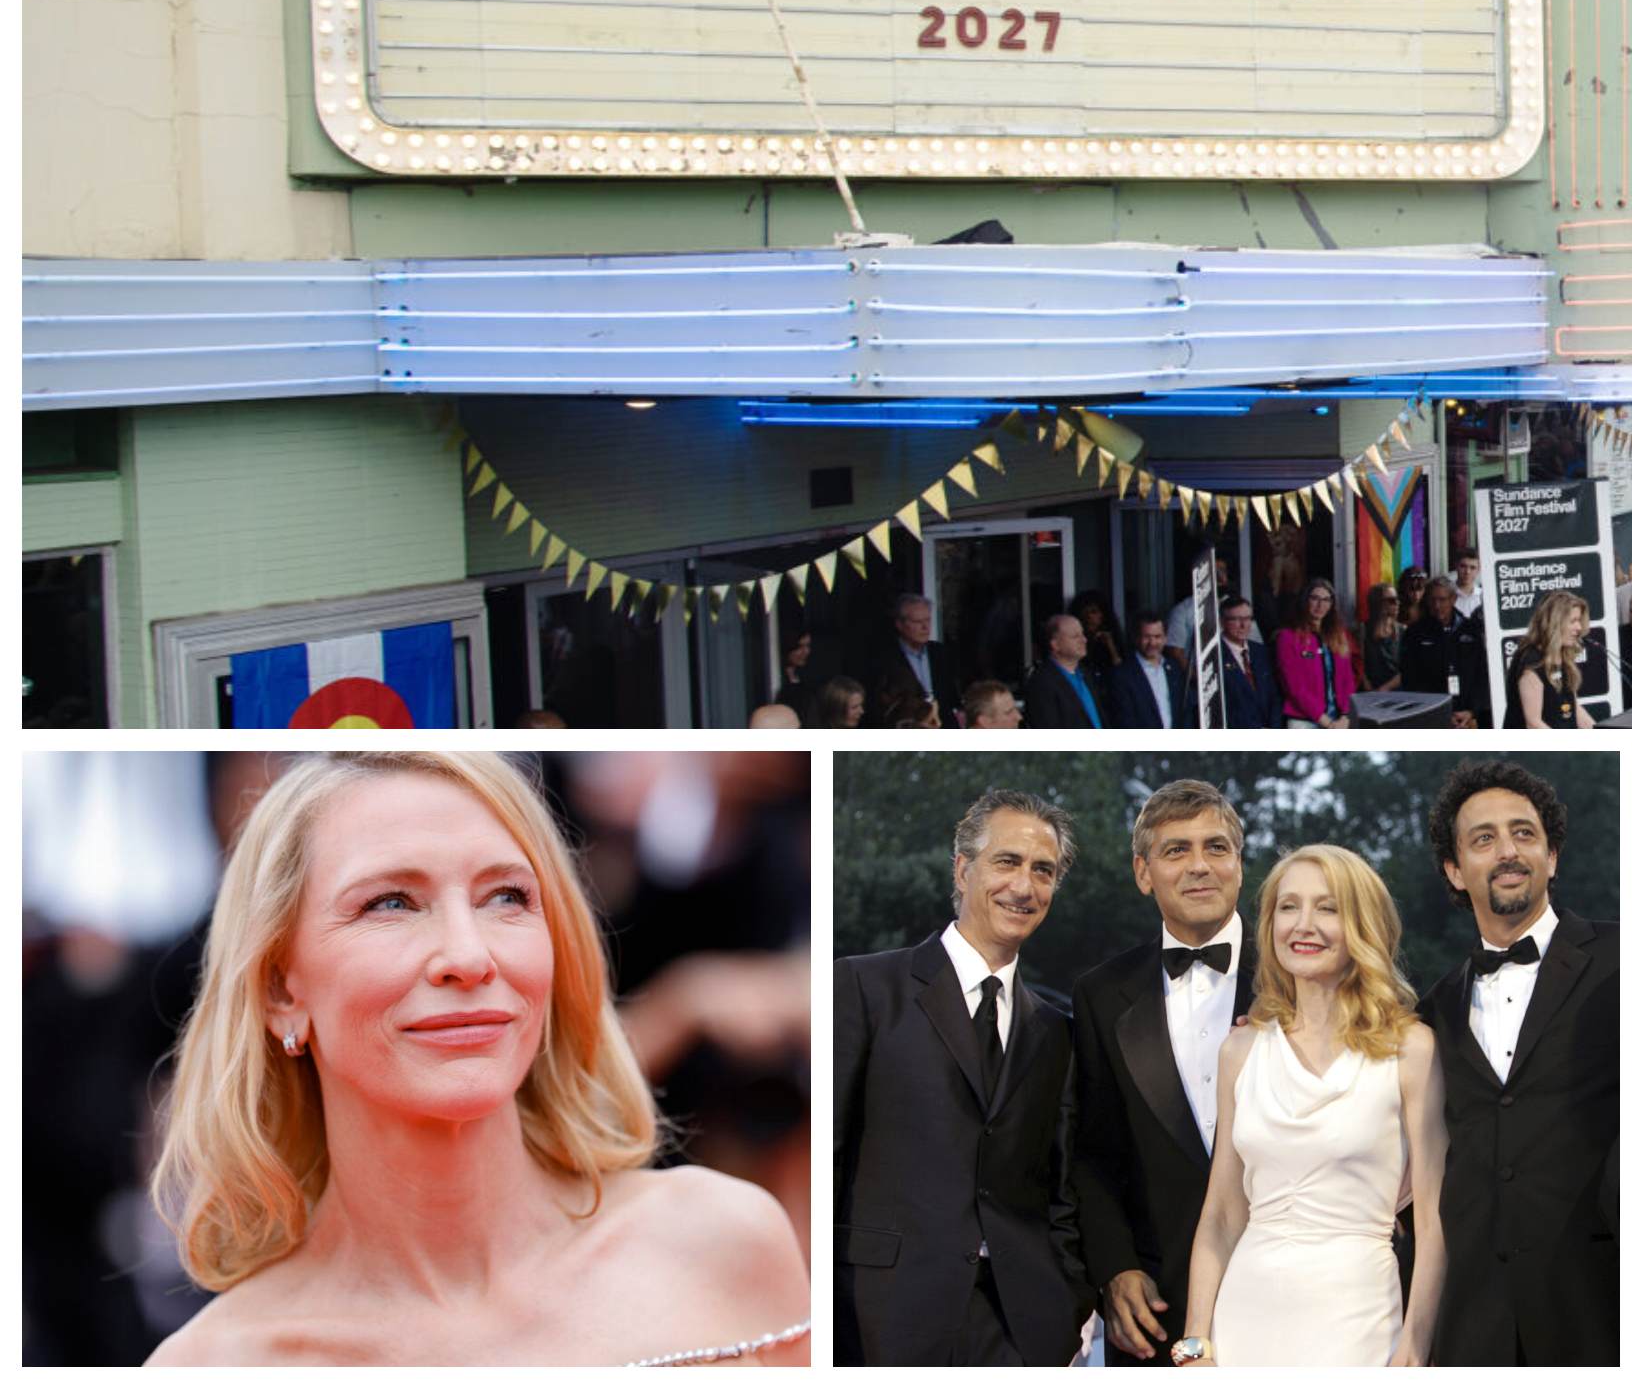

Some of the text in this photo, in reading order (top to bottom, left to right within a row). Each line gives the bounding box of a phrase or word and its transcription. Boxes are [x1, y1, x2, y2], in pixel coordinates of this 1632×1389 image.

[917, 5, 1062, 50] 2027
[1493, 487, 1562, 502] Sundance
[1494, 499, 1577, 518] Film Festival
[1495, 518, 1530, 533] 2027
[1499, 562, 1567, 579] Sundance
[1500, 574, 1582, 595] Film Festival
[1500, 593, 1535, 610] 2027
